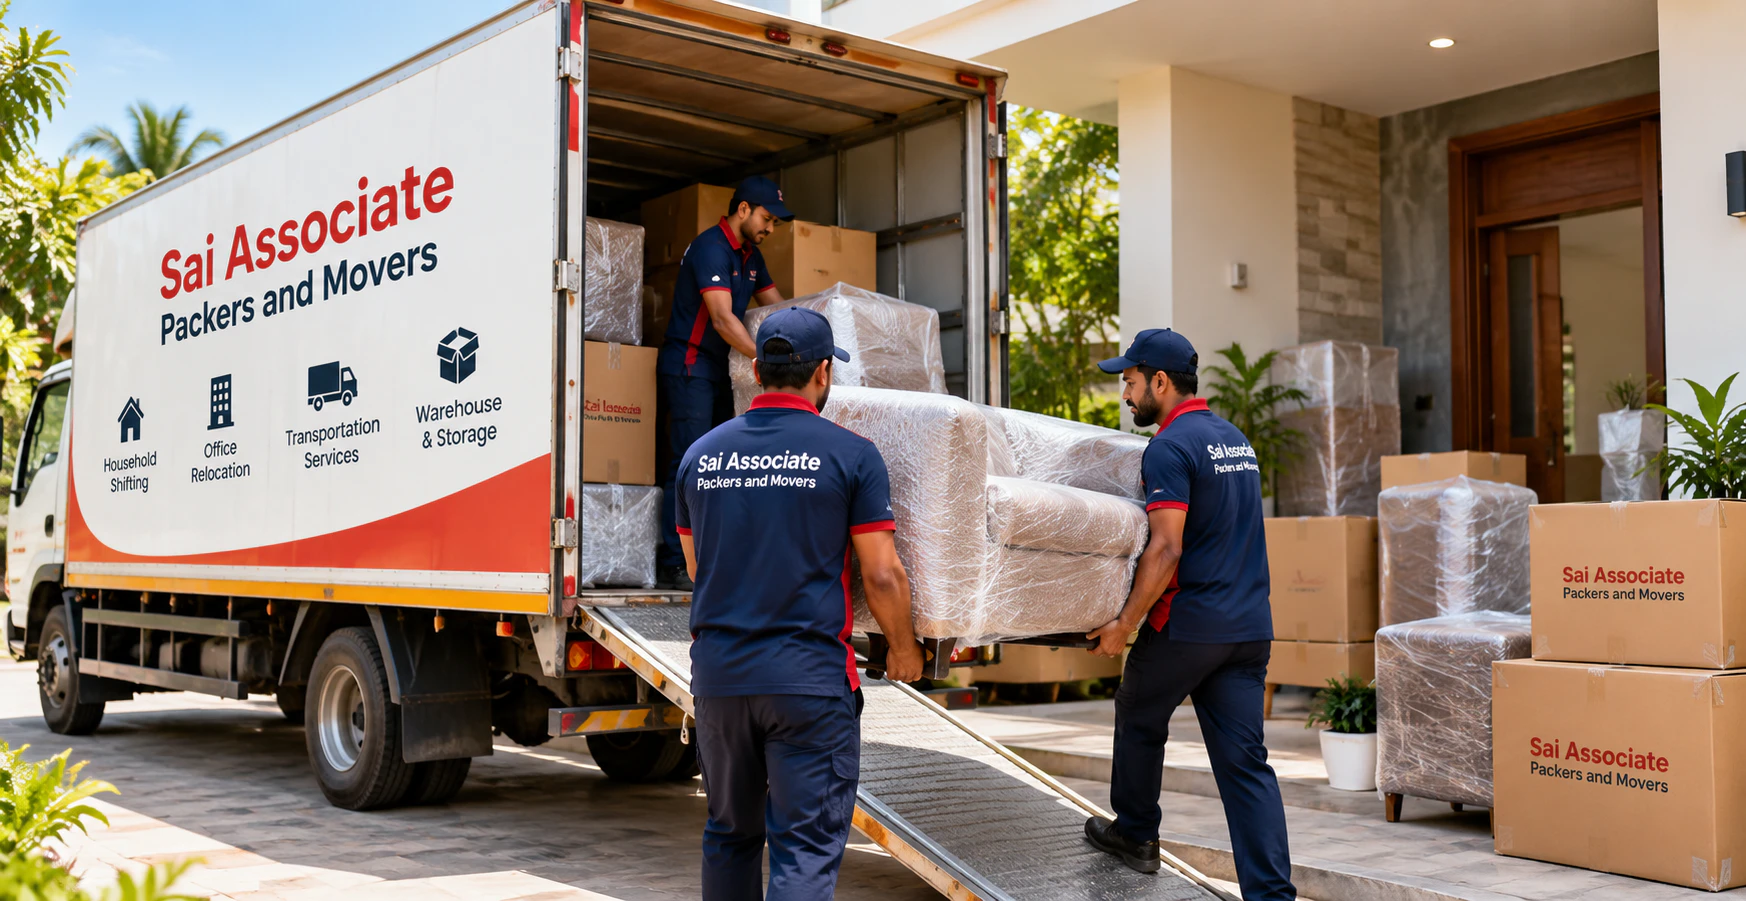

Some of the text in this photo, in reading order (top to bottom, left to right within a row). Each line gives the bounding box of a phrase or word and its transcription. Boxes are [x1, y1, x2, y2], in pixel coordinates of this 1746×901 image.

[160, 166, 455, 299] Sai Associate
[161, 242, 438, 346] Packers and Movers
[415, 396, 503, 424] Warehouse
[285, 417, 380, 447] Transportation
[421, 425, 498, 449] & Storage
[203, 440, 238, 459] Office
[304, 448, 360, 469] Services
[697, 449, 821, 474] Sai Associate
[103, 450, 157, 474] Household
[191, 461, 251, 484] Relocation
[110, 475, 149, 494] Shifting
[696, 474, 817, 491] Packers and Movers
[1563, 565, 1685, 585] Sai Associate
[1563, 586, 1685, 601] Packers and Movers
[1529, 736, 1669, 774] Sai Associate
[1530, 760, 1669, 793] Packers and Movers
